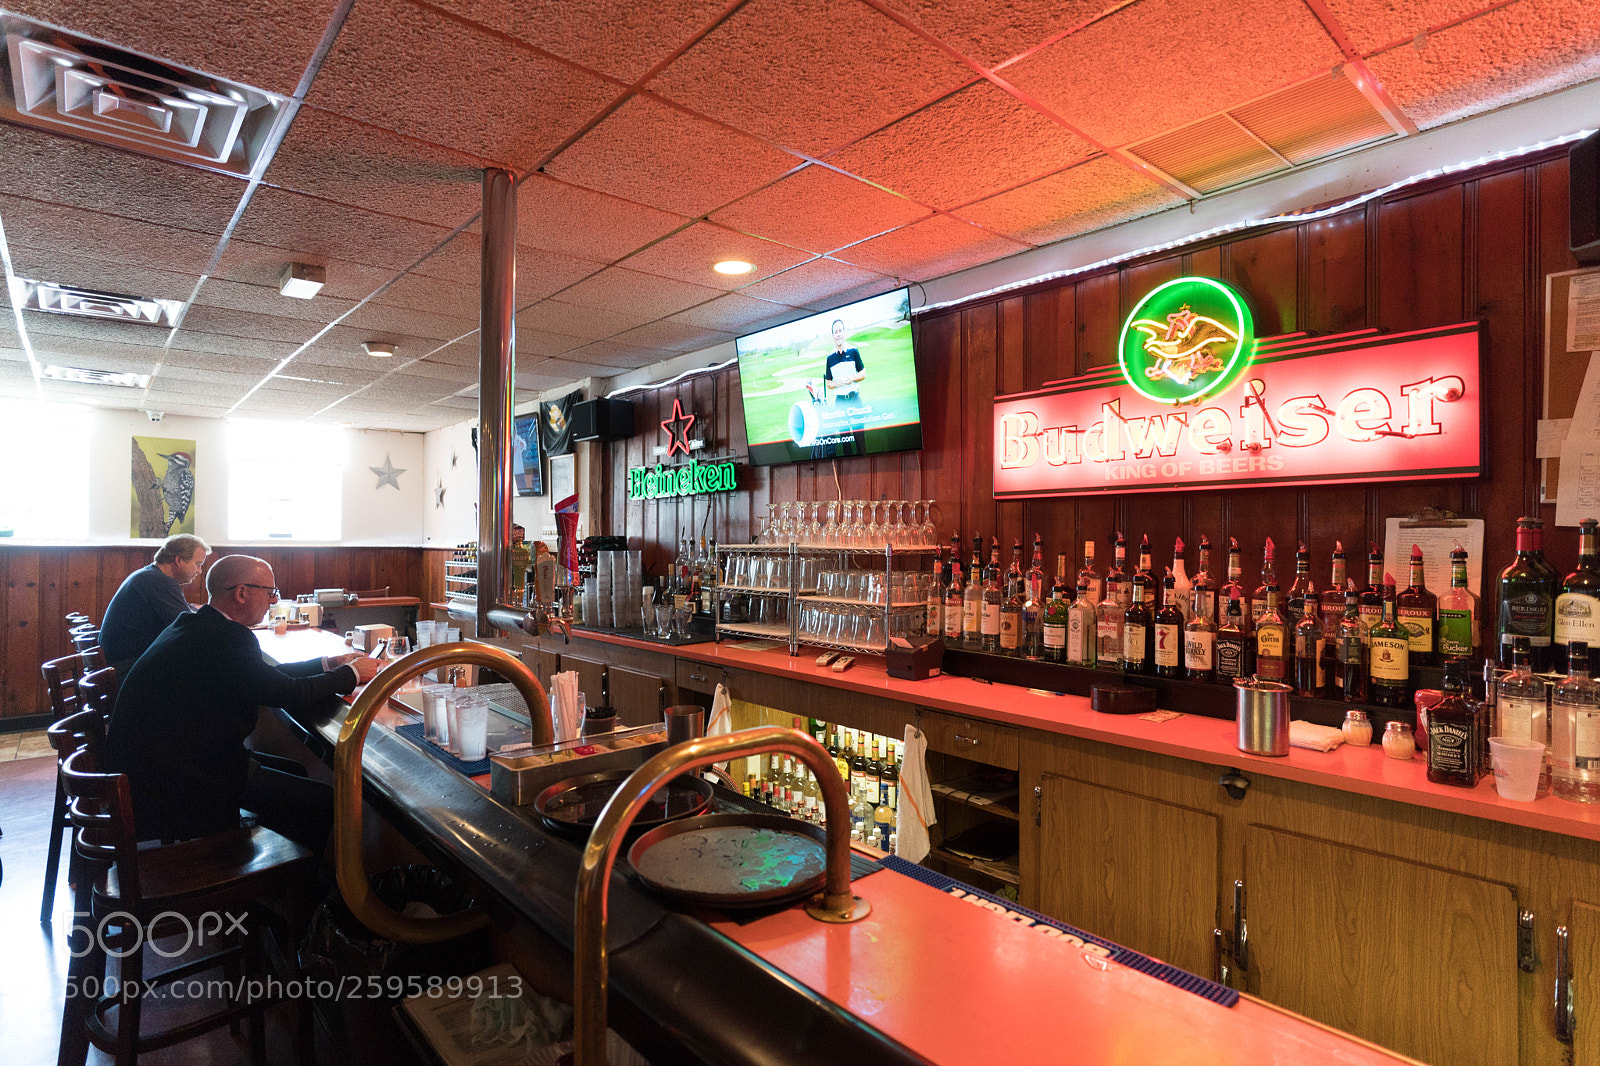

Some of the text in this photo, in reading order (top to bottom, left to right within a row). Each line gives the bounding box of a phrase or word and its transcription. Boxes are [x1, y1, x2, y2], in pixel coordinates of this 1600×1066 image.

[1000, 375, 1466, 470] Budweiser
[1105, 454, 1285, 480] KING OF BEERS
[629, 459, 737, 500] Heineken
[1398, 609, 1428, 617] LEROUX
[1556, 618, 1595, 629] Glen Ellen
[1370, 641, 1405, 650] JAMESON
